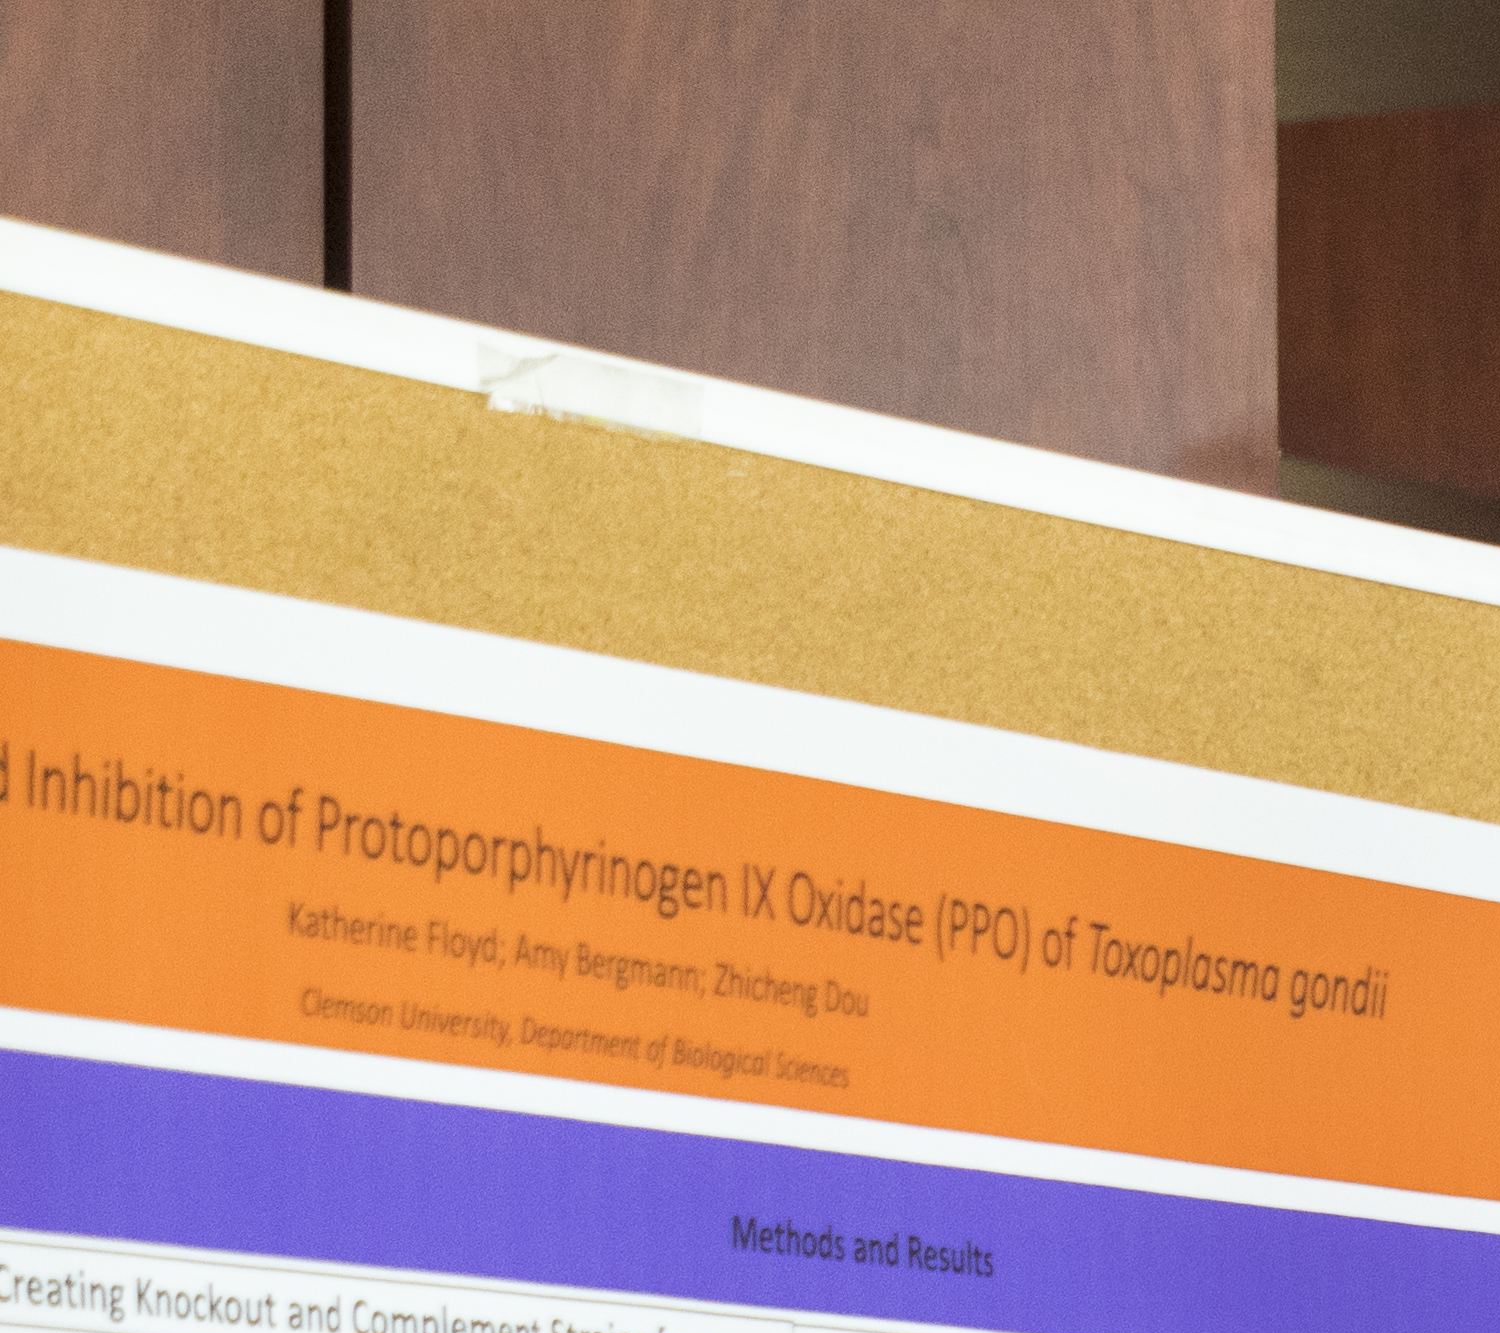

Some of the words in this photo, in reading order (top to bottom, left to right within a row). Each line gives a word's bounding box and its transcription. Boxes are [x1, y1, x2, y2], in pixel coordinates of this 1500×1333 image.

[25, 748, 243, 839] Inhibition
[256, 786, 305, 846] of
[315, 793, 728, 921] Protoporphyrinogen
[741, 863, 776, 921] IX
[786, 870, 925, 946] Oxidase
[934, 893, 1031, 974] (PPO)
[1041, 914, 1079, 969] of
[1088, 920, 1281, 1003] Toxoplasma
[1289, 966, 1389, 1020] gondii
[286, 900, 419, 953] Katherine
[425, 919, 507, 970] Floyd;
[513, 933, 570, 981] Amy
[574, 941, 706, 999] Bergmann;
[712, 961, 819, 1020] Zhicheng
[823, 978, 870, 1019] Dou
[298, 985, 394, 1027] Clemson
[398, 1000, 514, 1049] University,
[519, 1015, 643, 1062] Department
[644, 1033, 670, 1071] of
[674, 1038, 770, 1075] Biological
[774, 1050, 850, 1090] Sciences
[0, 1265, 123, 1321] Creating
[135, 1278, 276, 1329] Knockout
[731, 1214, 847, 1263] Methods
[852, 1232, 900, 1268] and
[906, 1234, 995, 1279] Results
